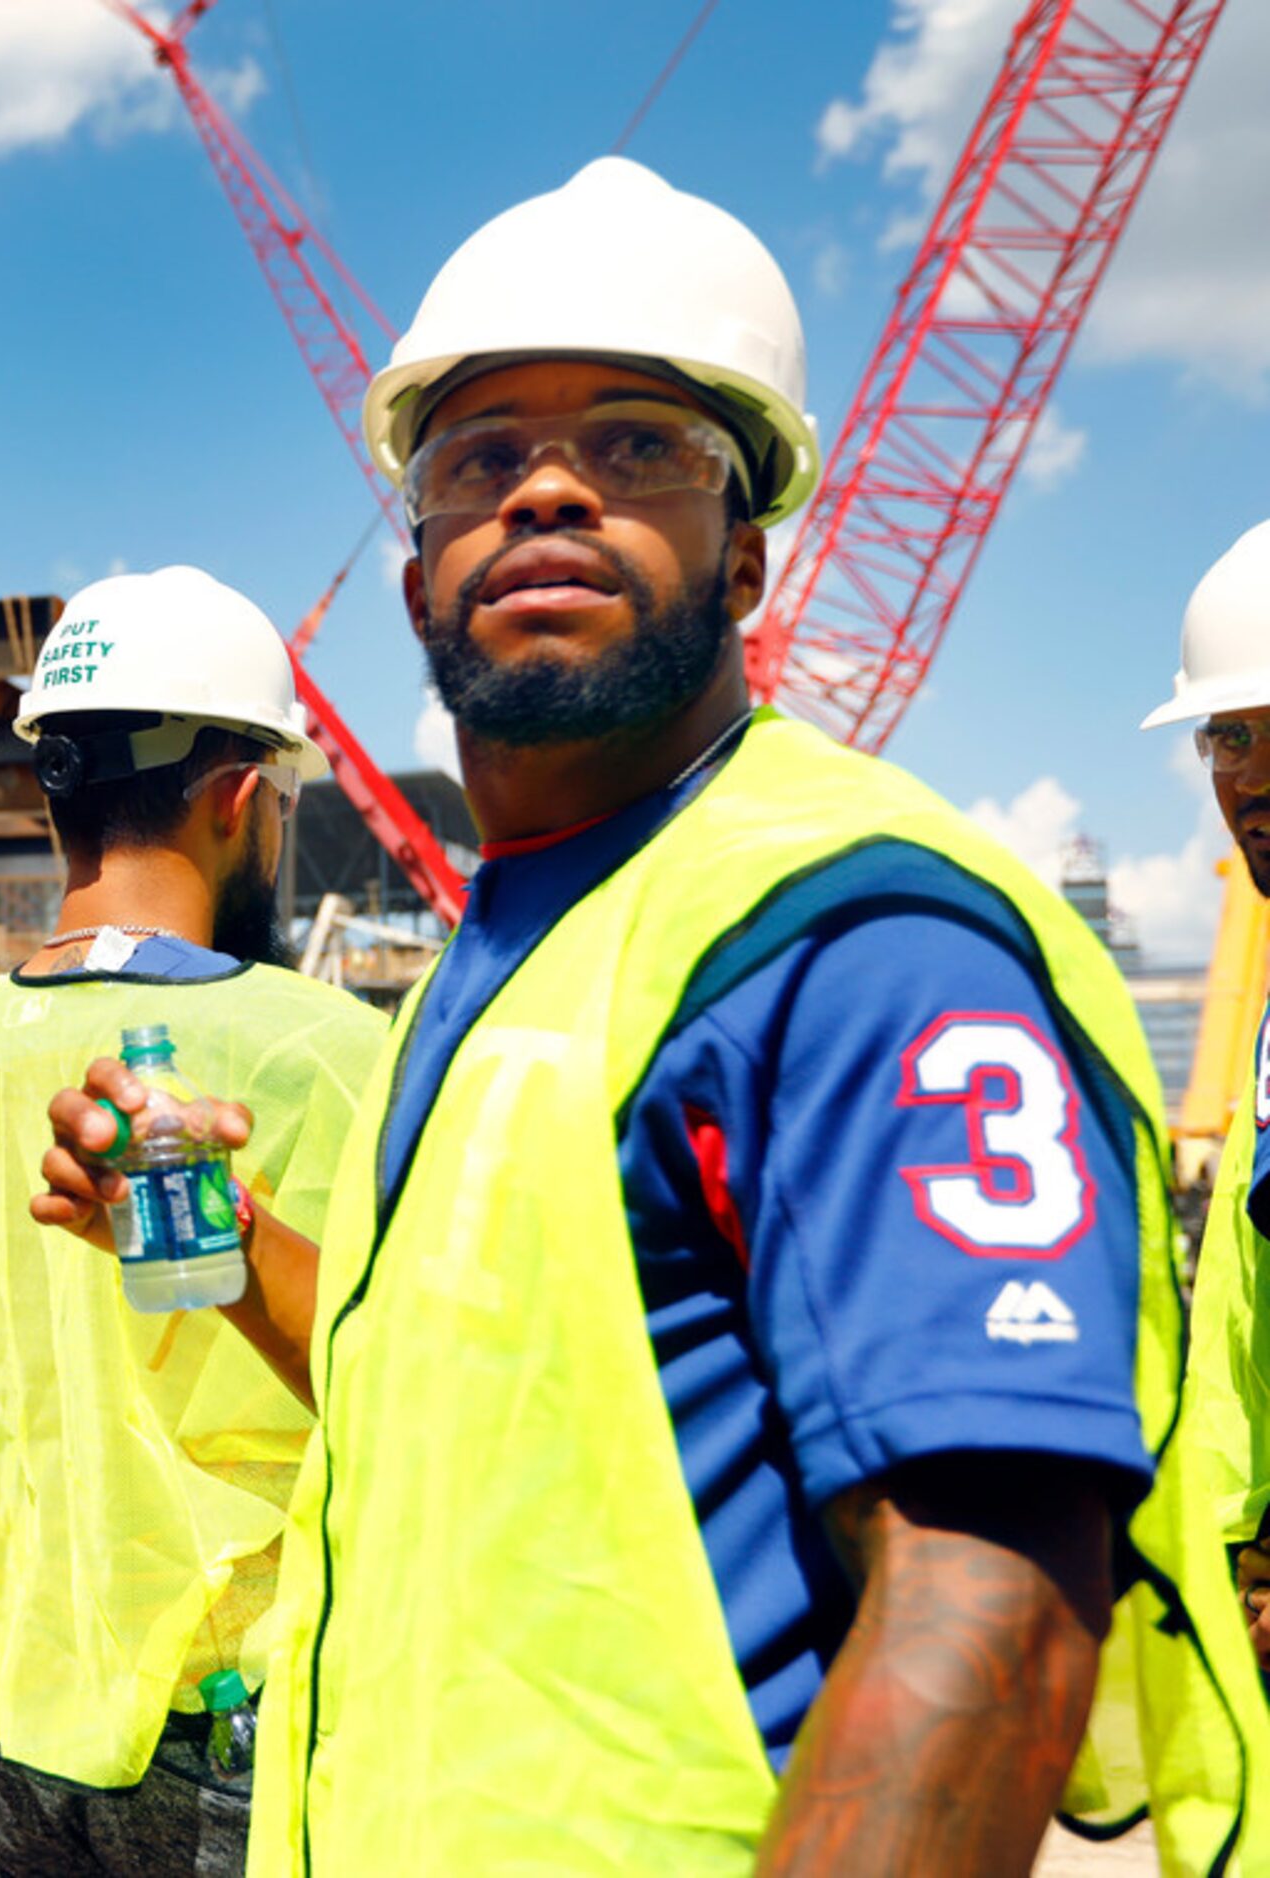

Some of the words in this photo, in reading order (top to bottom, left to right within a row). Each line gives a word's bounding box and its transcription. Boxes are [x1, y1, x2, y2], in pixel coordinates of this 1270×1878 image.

[59, 619, 100, 638] PUT
[42, 641, 115, 668] SAFETY
[42, 665, 99, 690] FIRST
[898, 1011, 1097, 1259] 3
